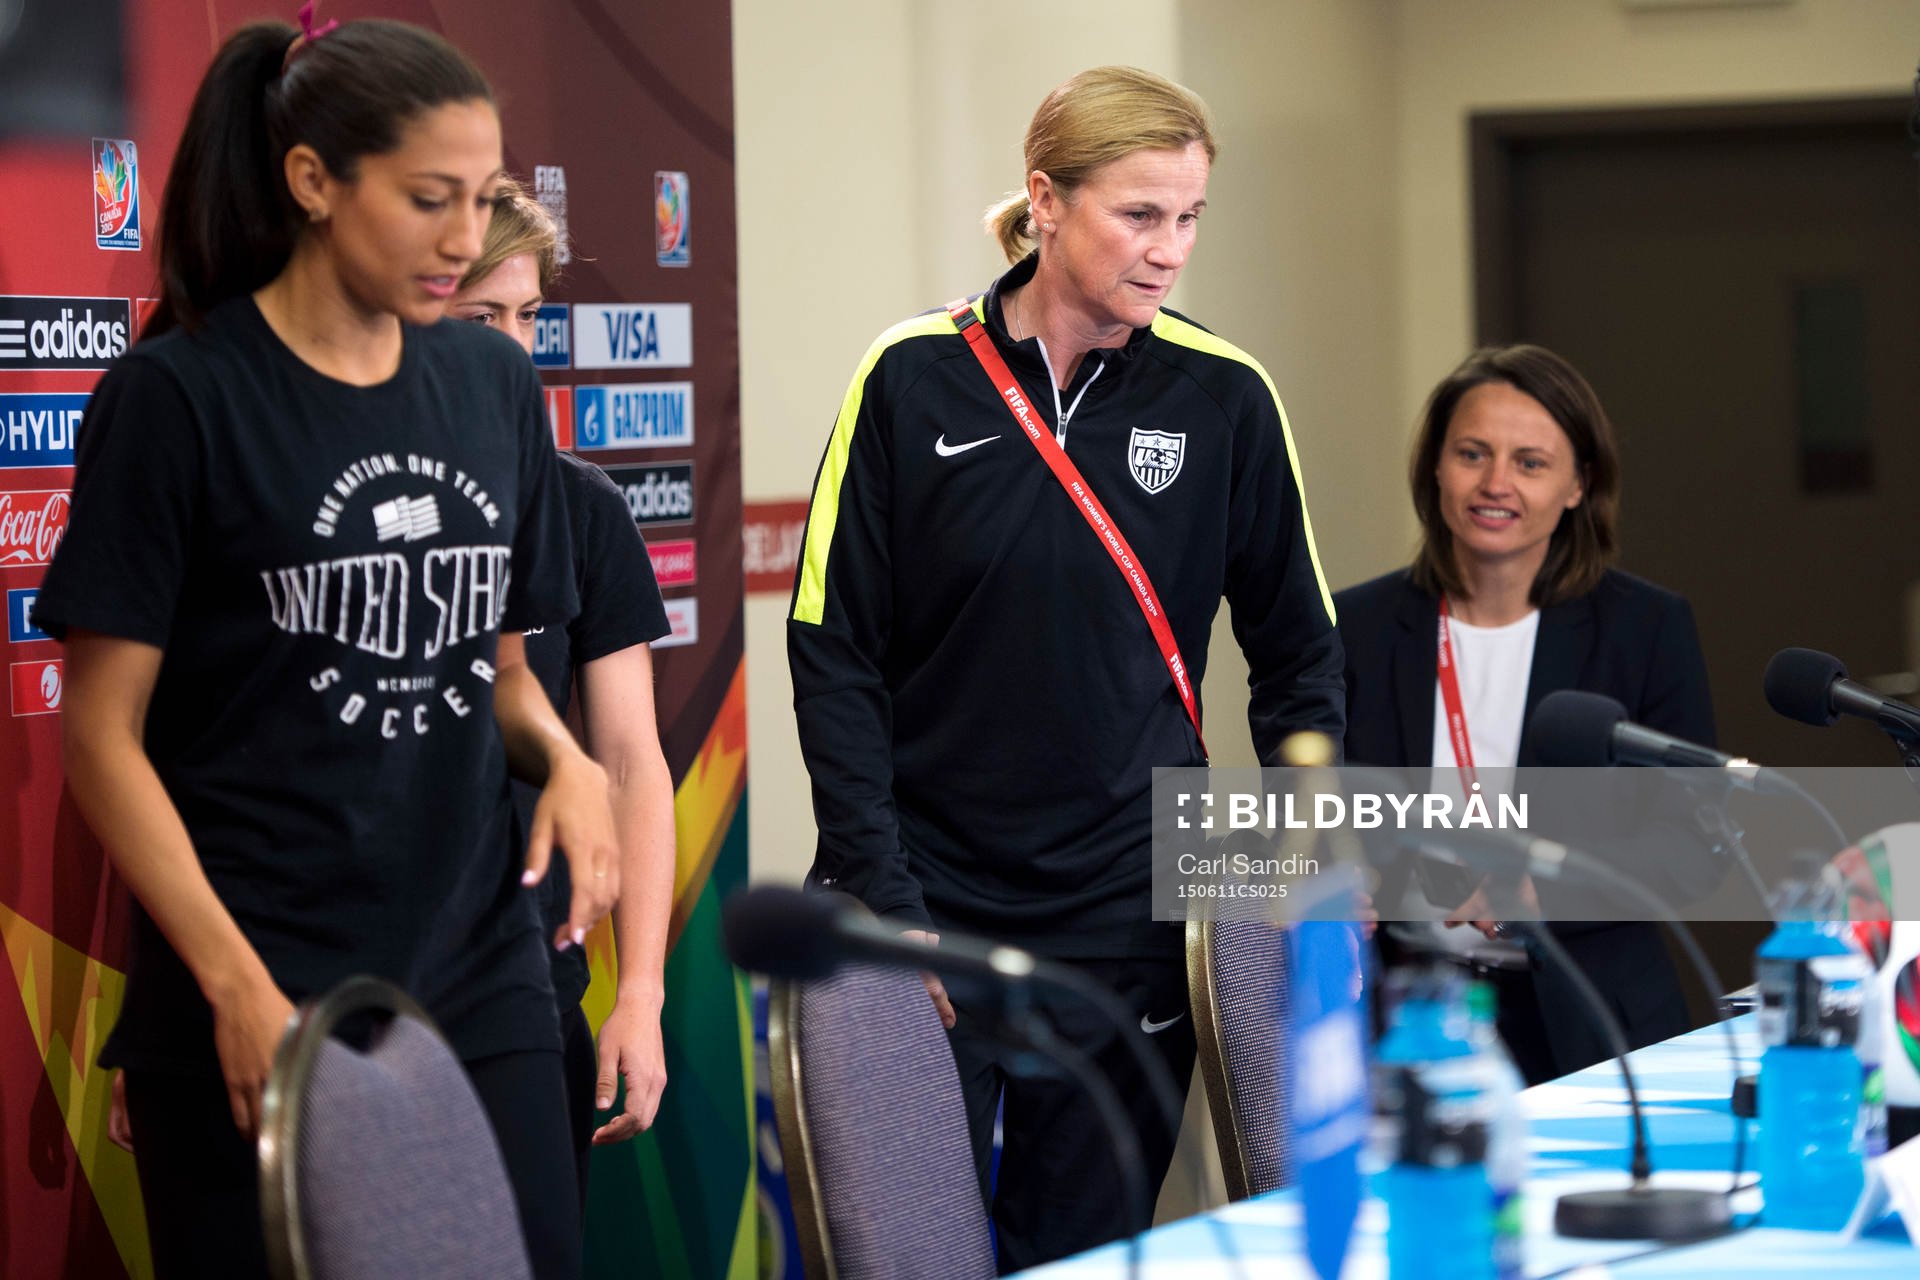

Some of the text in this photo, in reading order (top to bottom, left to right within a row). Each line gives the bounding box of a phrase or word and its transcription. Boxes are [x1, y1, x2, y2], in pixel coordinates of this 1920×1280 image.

[123, 228, 138, 240] FIFA
[30, 308, 127, 358] adidas
[603, 310, 660, 361] VISA
[614, 392, 684, 440] GAZPROM
[1004, 386, 1041, 440] FIFA.com
[1135, 447, 1177, 470] US
[313, 454, 500, 537] ONE NATION. ONE TEAM.
[626, 471, 692, 517] adidas
[1071, 481, 1084, 498] FIFA
[1081, 495, 1108, 531] WOMEN'S
[1104, 529, 1124, 556] WORLD
[1120, 554, 1134, 571] CUP
[1129, 568, 1148, 598] CANADA
[260, 552, 410, 659] UNITED
[310, 658, 496, 739] SOCCER
